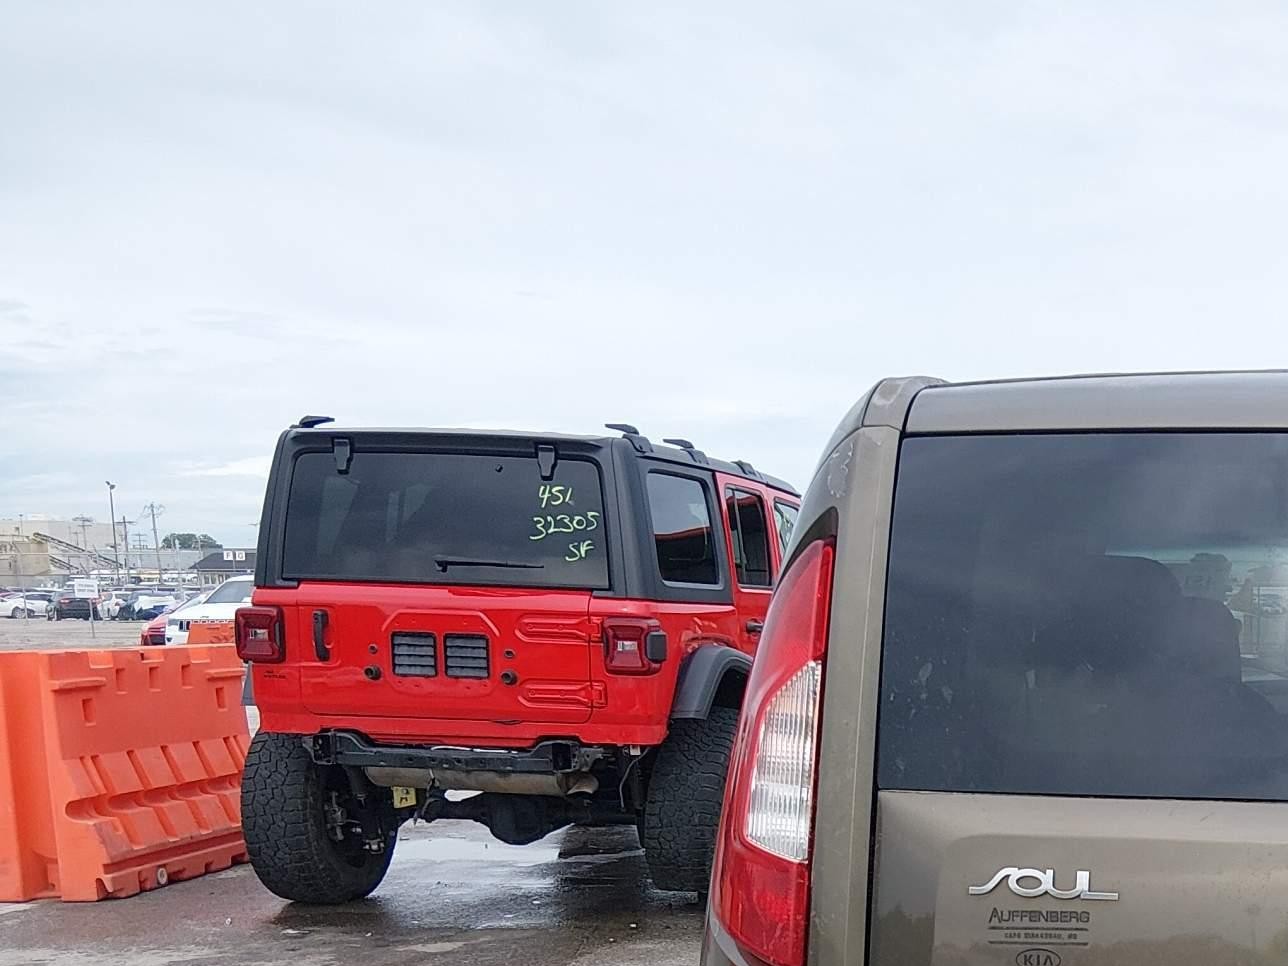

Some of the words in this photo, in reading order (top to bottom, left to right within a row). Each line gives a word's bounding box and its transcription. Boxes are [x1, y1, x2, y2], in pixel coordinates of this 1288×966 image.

[529, 511, 600, 540] 32305
[565, 540, 595, 561] SF
[988, 907, 1091, 924] AUFFENBERG
[1023, 954, 1054, 966] KIA
